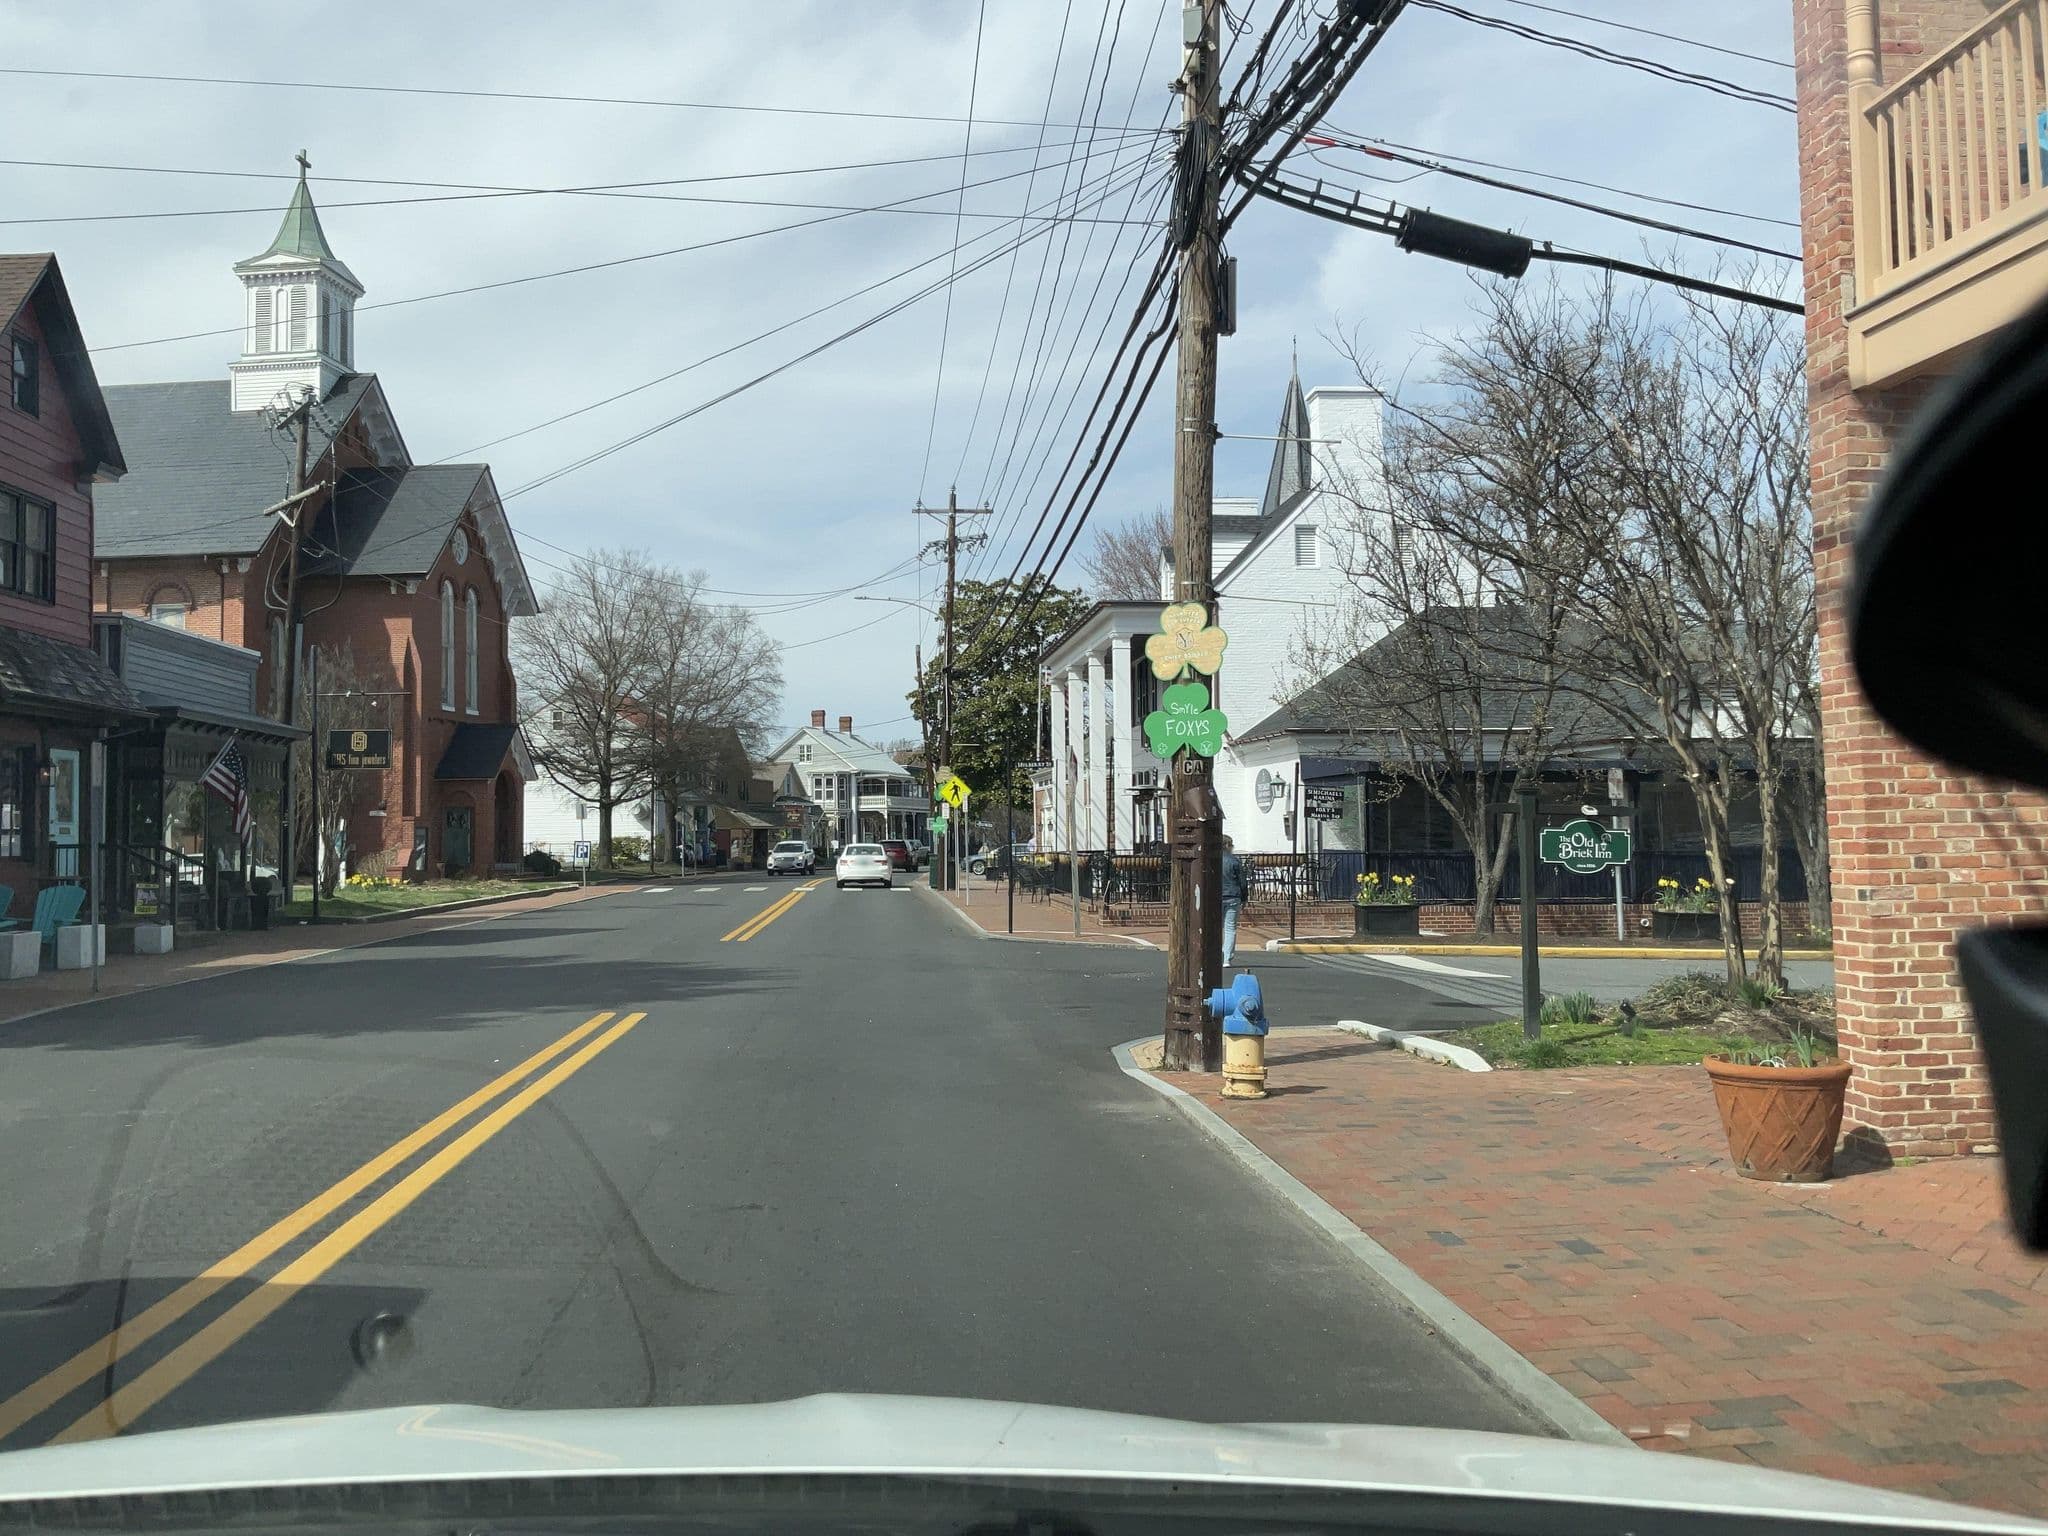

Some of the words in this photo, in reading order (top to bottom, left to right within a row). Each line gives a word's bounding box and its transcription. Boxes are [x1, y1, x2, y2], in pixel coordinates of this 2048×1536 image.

[1165, 719, 1210, 737] FOXYS
[1571, 832, 1594, 847] Old
[1558, 842, 1593, 859] Brick
[1595, 843, 1612, 858] Inn
